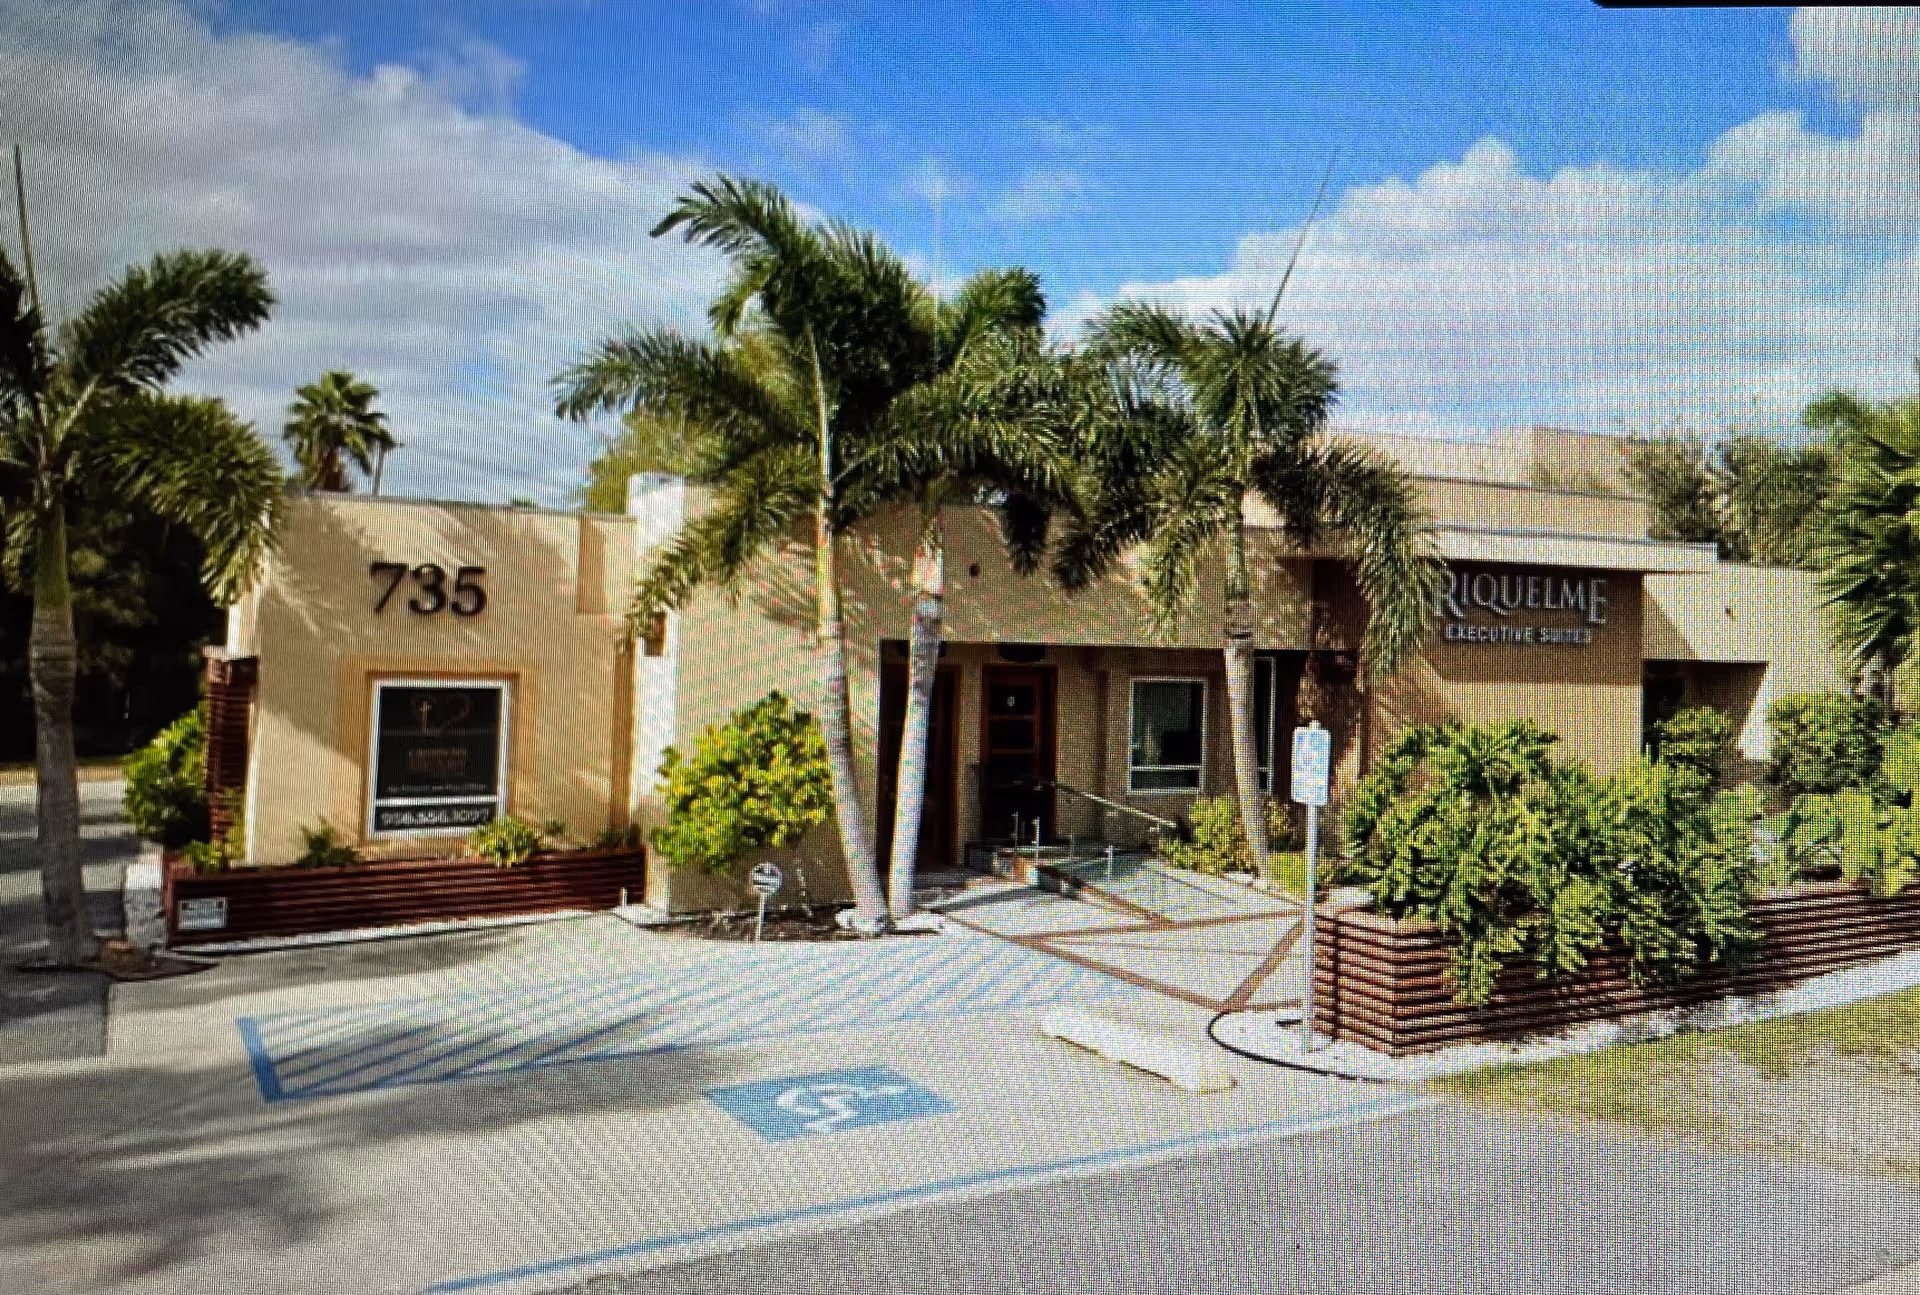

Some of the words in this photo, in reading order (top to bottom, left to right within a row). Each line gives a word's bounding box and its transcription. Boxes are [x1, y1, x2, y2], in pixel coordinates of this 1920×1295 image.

[369, 562, 488, 616] 735
[1433, 568, 1608, 624] RIQUELME
[1446, 624, 1534, 642] EXECUTIVE
[1538, 626, 1594, 644] SUITES
